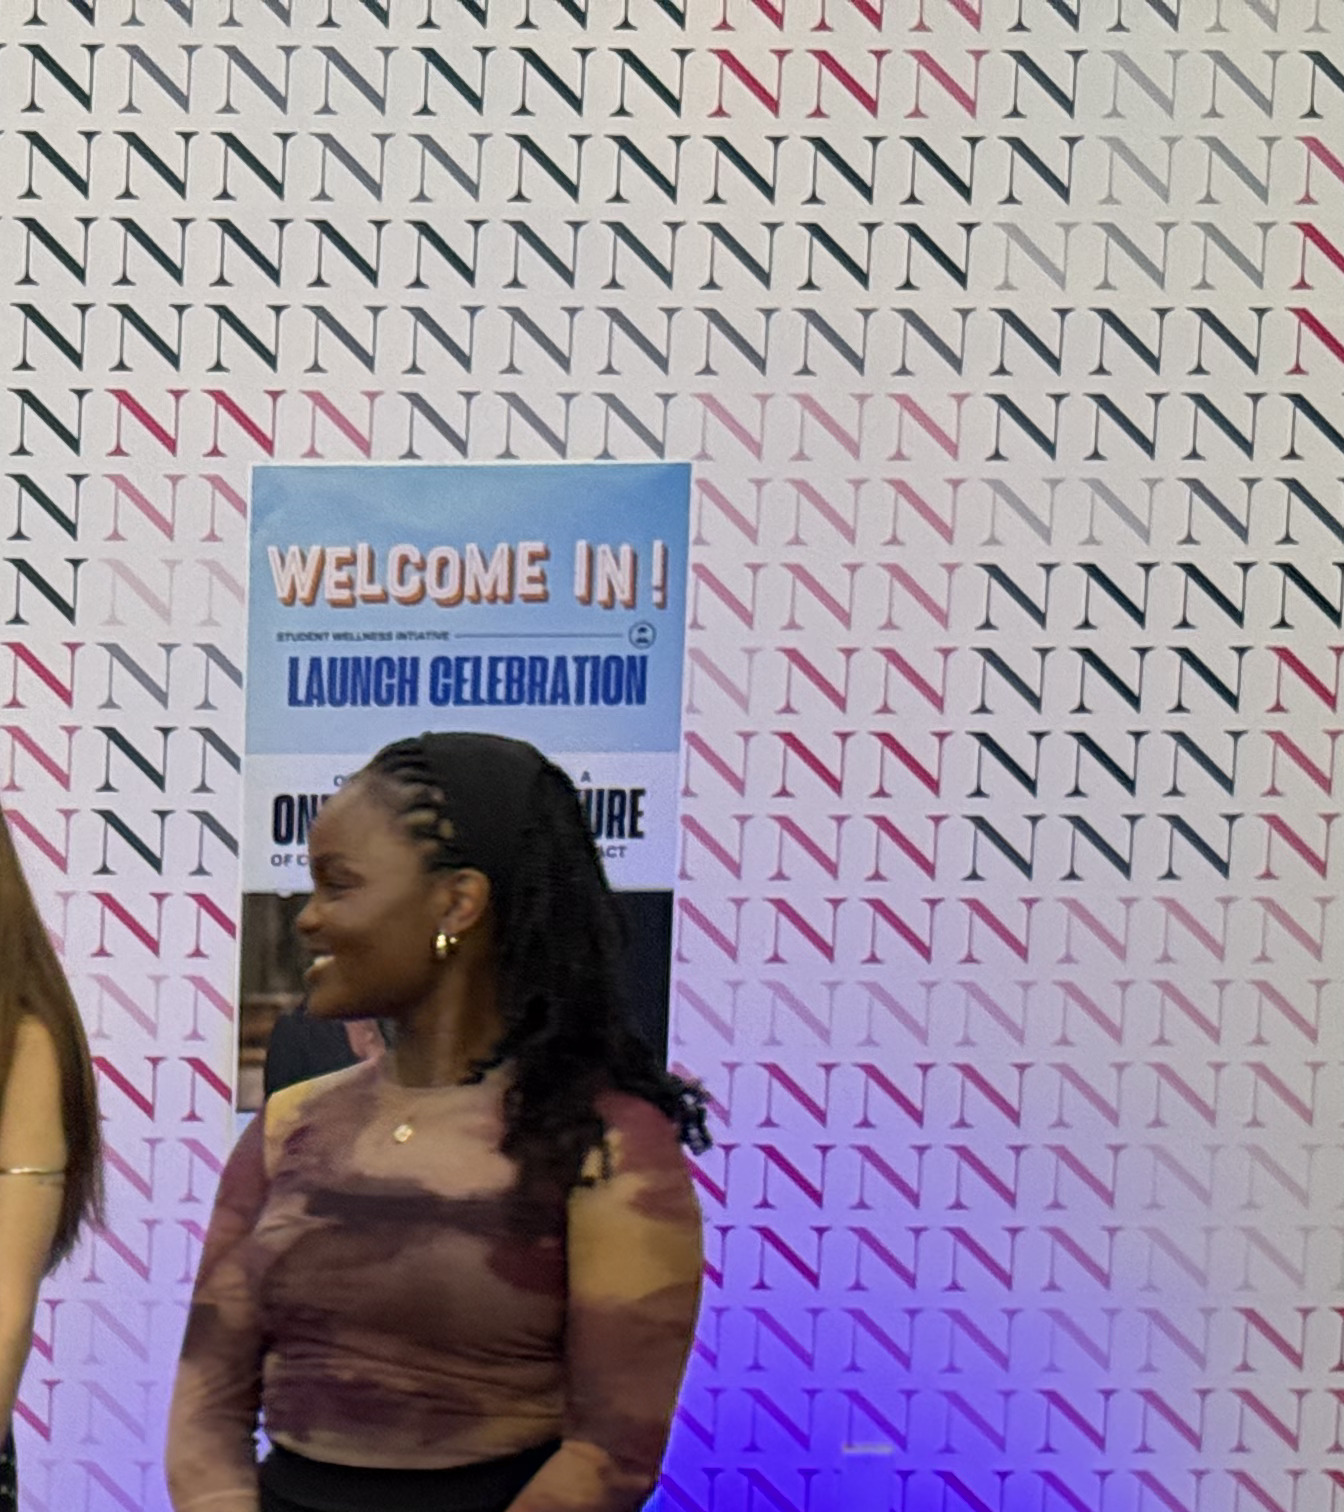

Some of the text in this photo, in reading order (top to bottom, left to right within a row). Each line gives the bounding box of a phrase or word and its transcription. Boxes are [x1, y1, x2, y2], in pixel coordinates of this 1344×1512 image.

[267, 541, 550, 607] WELCOME
[276, 631, 329, 642] STUDENT
[332, 631, 393, 642] WELLNESS
[287, 655, 648, 707] LAUNCH CELEBRATION
